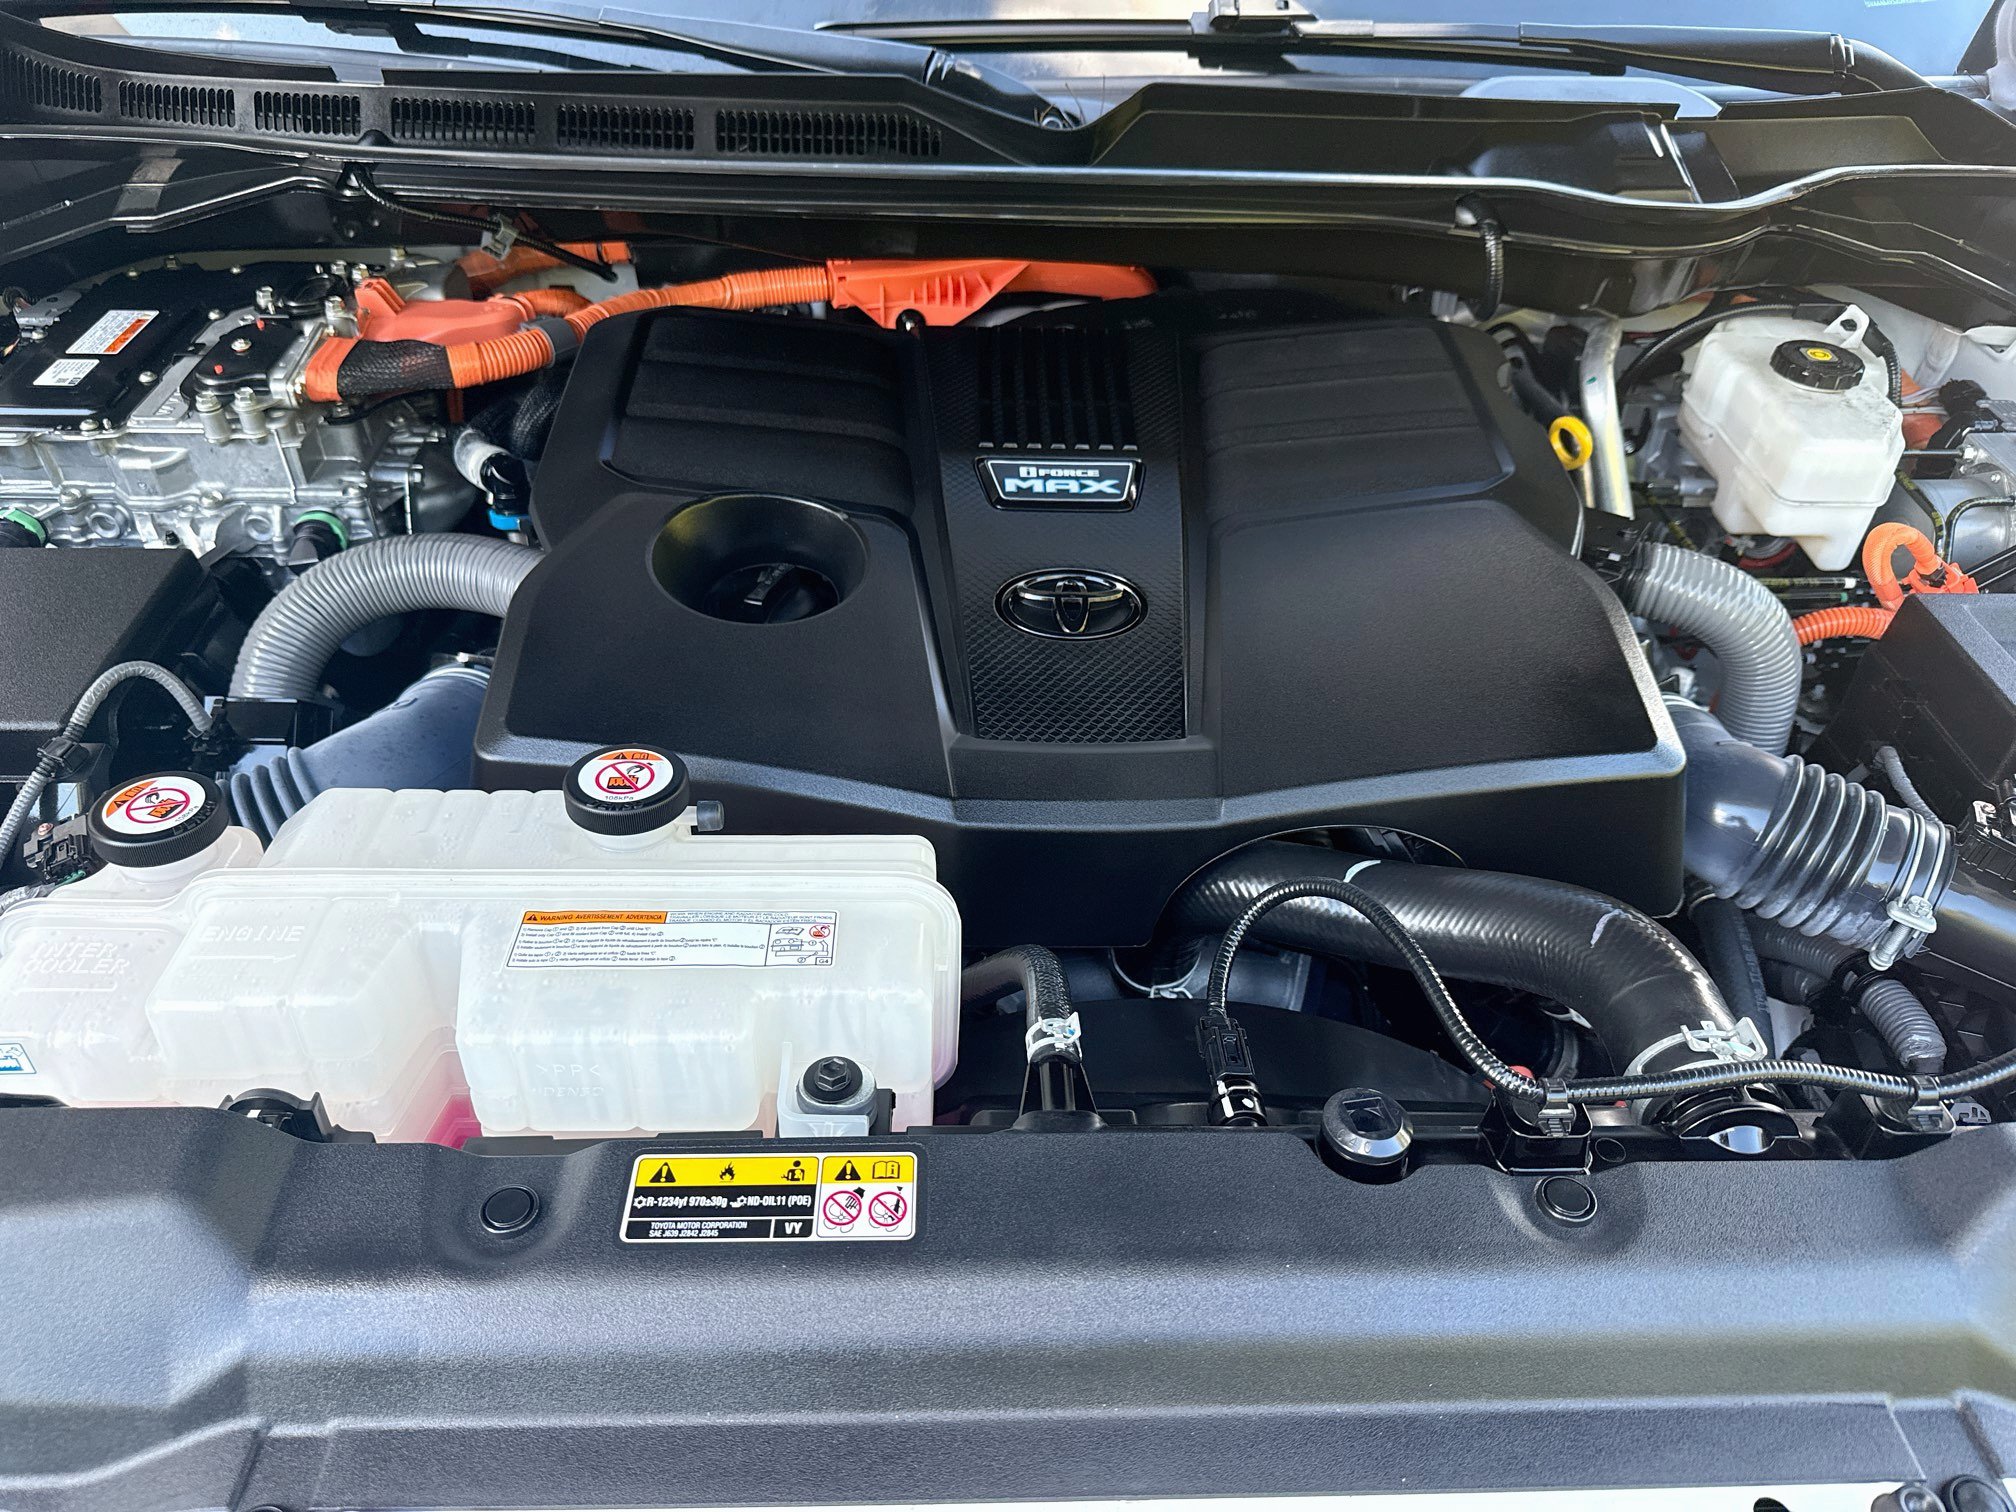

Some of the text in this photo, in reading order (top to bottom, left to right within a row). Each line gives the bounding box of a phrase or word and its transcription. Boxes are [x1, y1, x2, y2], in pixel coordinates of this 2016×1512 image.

[1004, 478, 1121, 494] MAX
[201, 925, 305, 942] ENGINE
[32, 942, 118, 958] INTER
[24, 958, 130, 974] COOLER
[544, 1086, 604, 1097] DENSO
[646, 1195, 688, 1209] R-1234yf
[788, 1194, 812, 1208] (POE)
[677, 1221, 701, 1229] MOTOR
[701, 1221, 748, 1229] CORPORATION
[784, 1222, 803, 1235] VY
[699, 1229, 719, 1237] J2845
